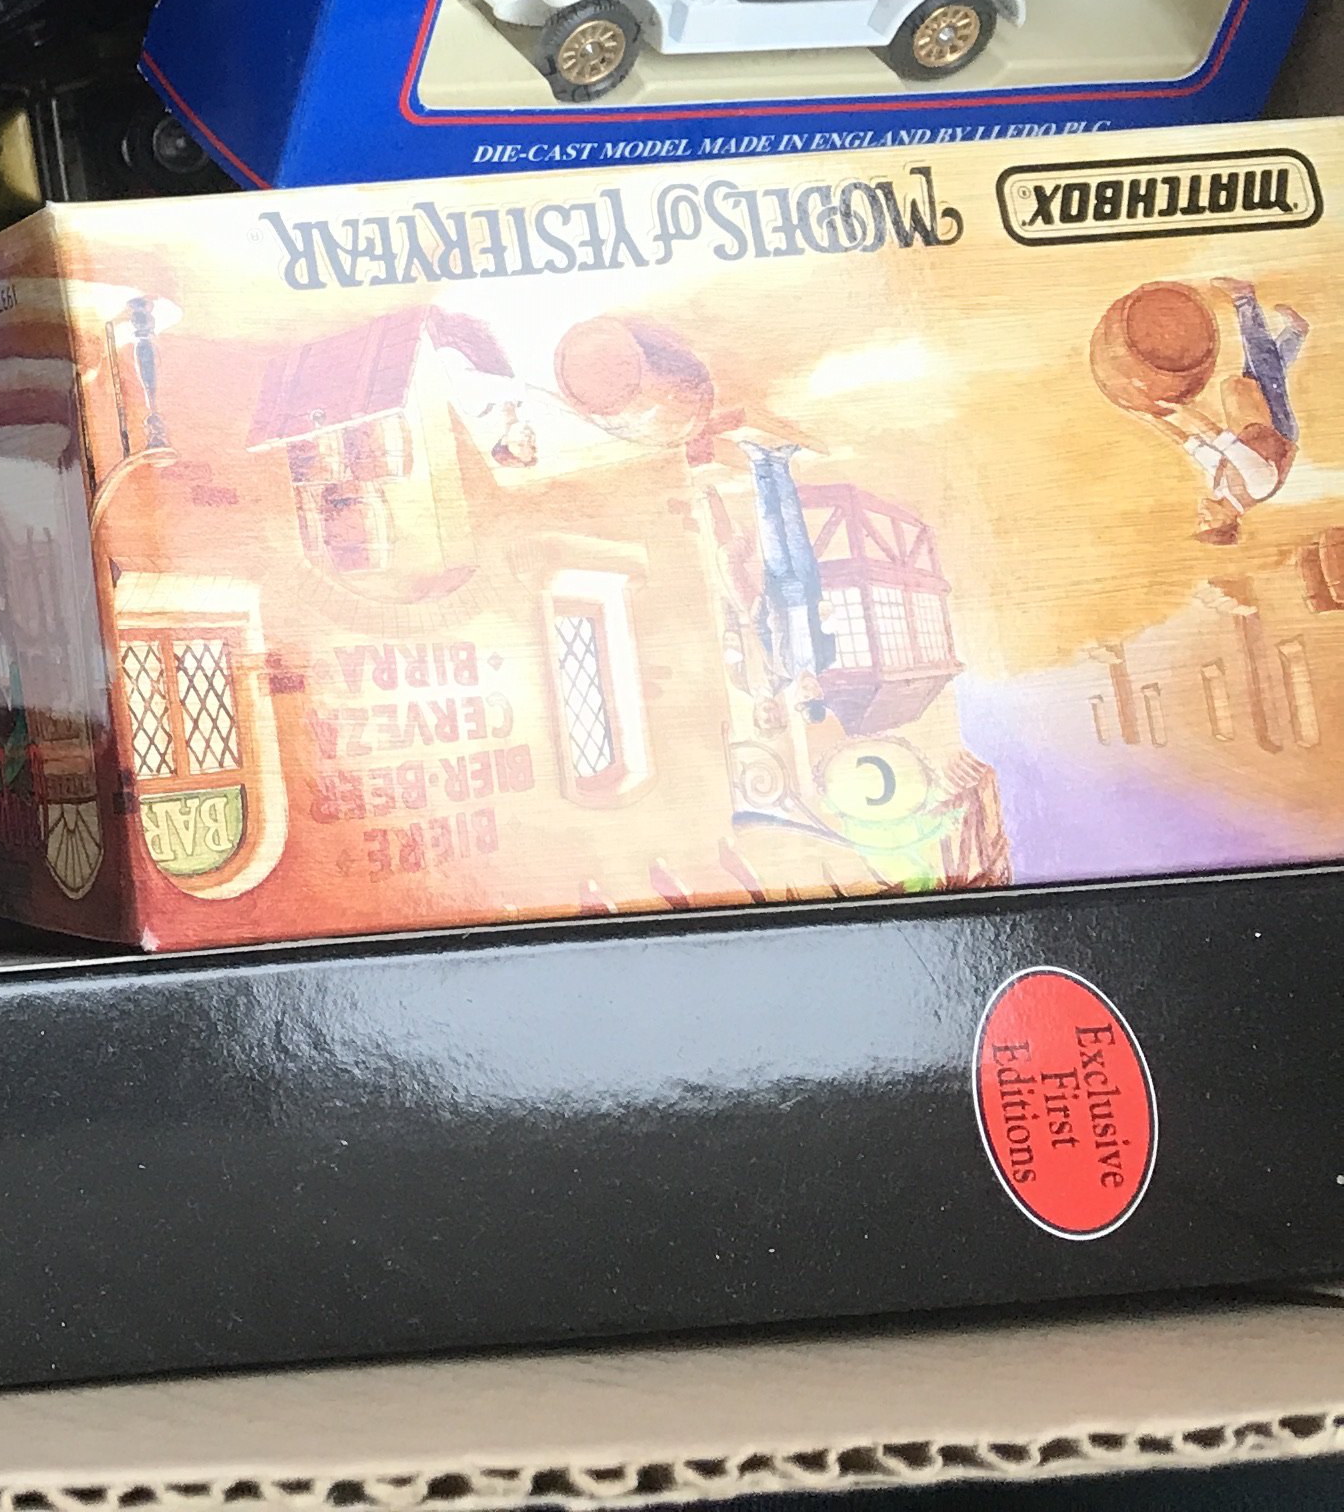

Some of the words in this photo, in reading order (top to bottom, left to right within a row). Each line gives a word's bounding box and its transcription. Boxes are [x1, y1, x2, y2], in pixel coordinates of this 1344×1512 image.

[473, 143, 598, 164] DIE-CAST
[602, 138, 697, 160] MODEL
[699, 133, 774, 156] MADE
[779, 131, 808, 153] IN
[809, 126, 935, 152] ENGLAND
[938, 125, 971, 145] BY
[1023, 168, 1296, 230] MATCHBOX
[264, 184, 653, 290] YESTERYEAR
[334, 640, 480, 690] BIRRA
[148, 796, 233, 861] BAR
[365, 809, 500, 882] BIERE
[991, 1040, 1038, 1185] Editions
[1040, 1066, 1081, 1149] First
[1074, 1022, 1133, 1189] Exclusive
